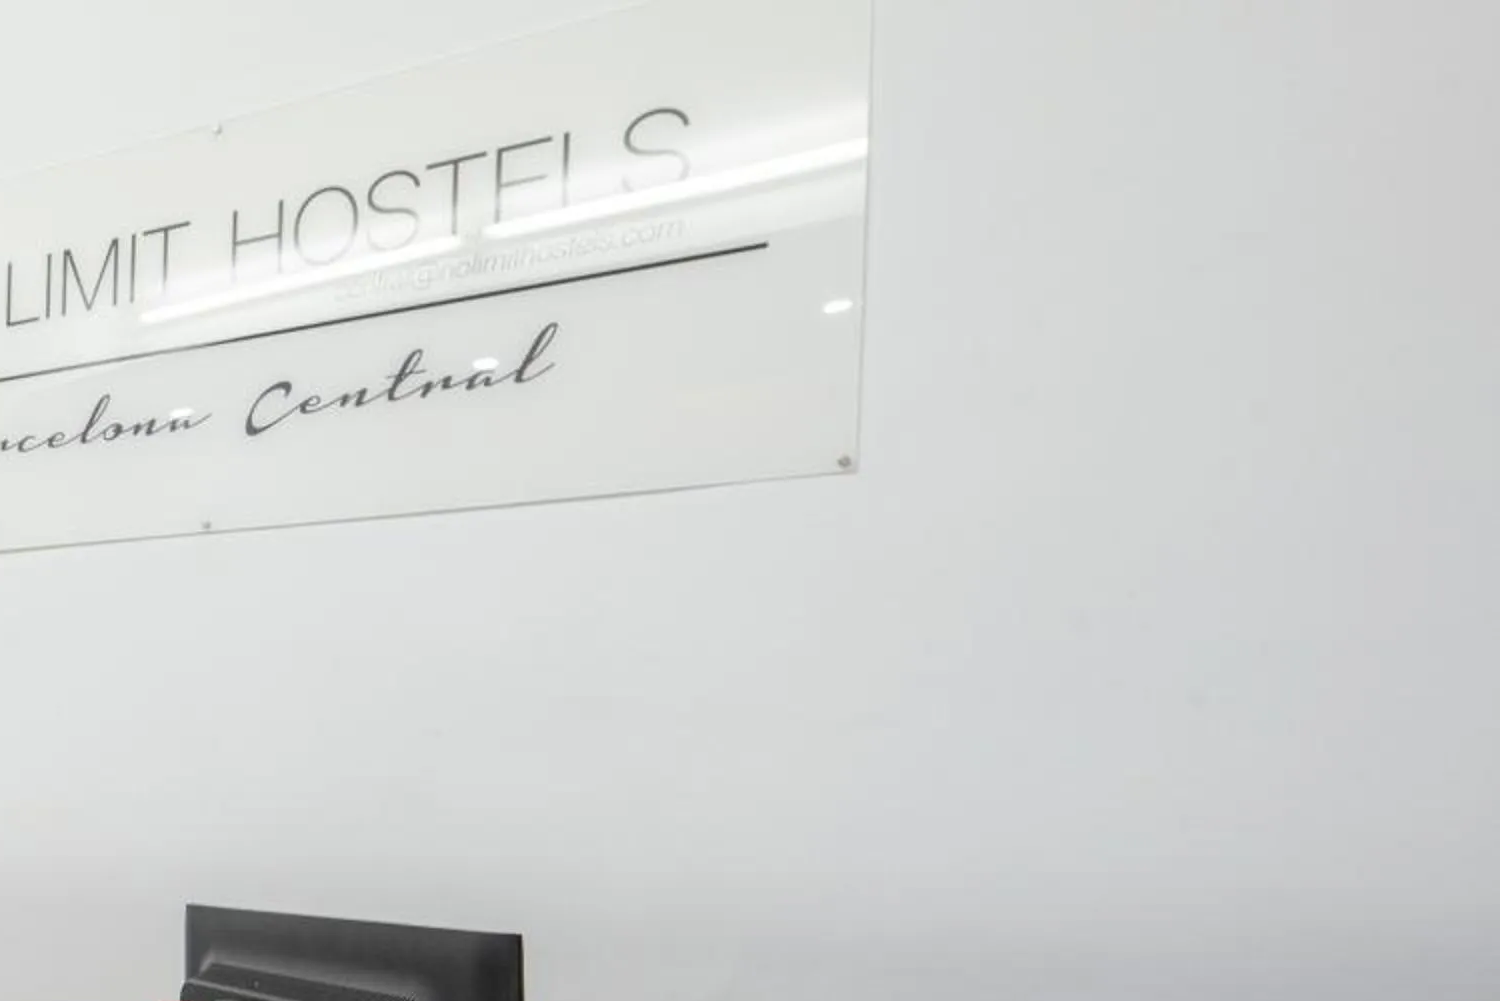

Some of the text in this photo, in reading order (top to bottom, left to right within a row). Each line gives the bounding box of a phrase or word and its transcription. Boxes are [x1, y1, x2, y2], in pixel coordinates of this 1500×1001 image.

[4, 219, 192, 328] LIMIT
[230, 106, 691, 284] HOSTELS
[244, 321, 558, 437] Central
